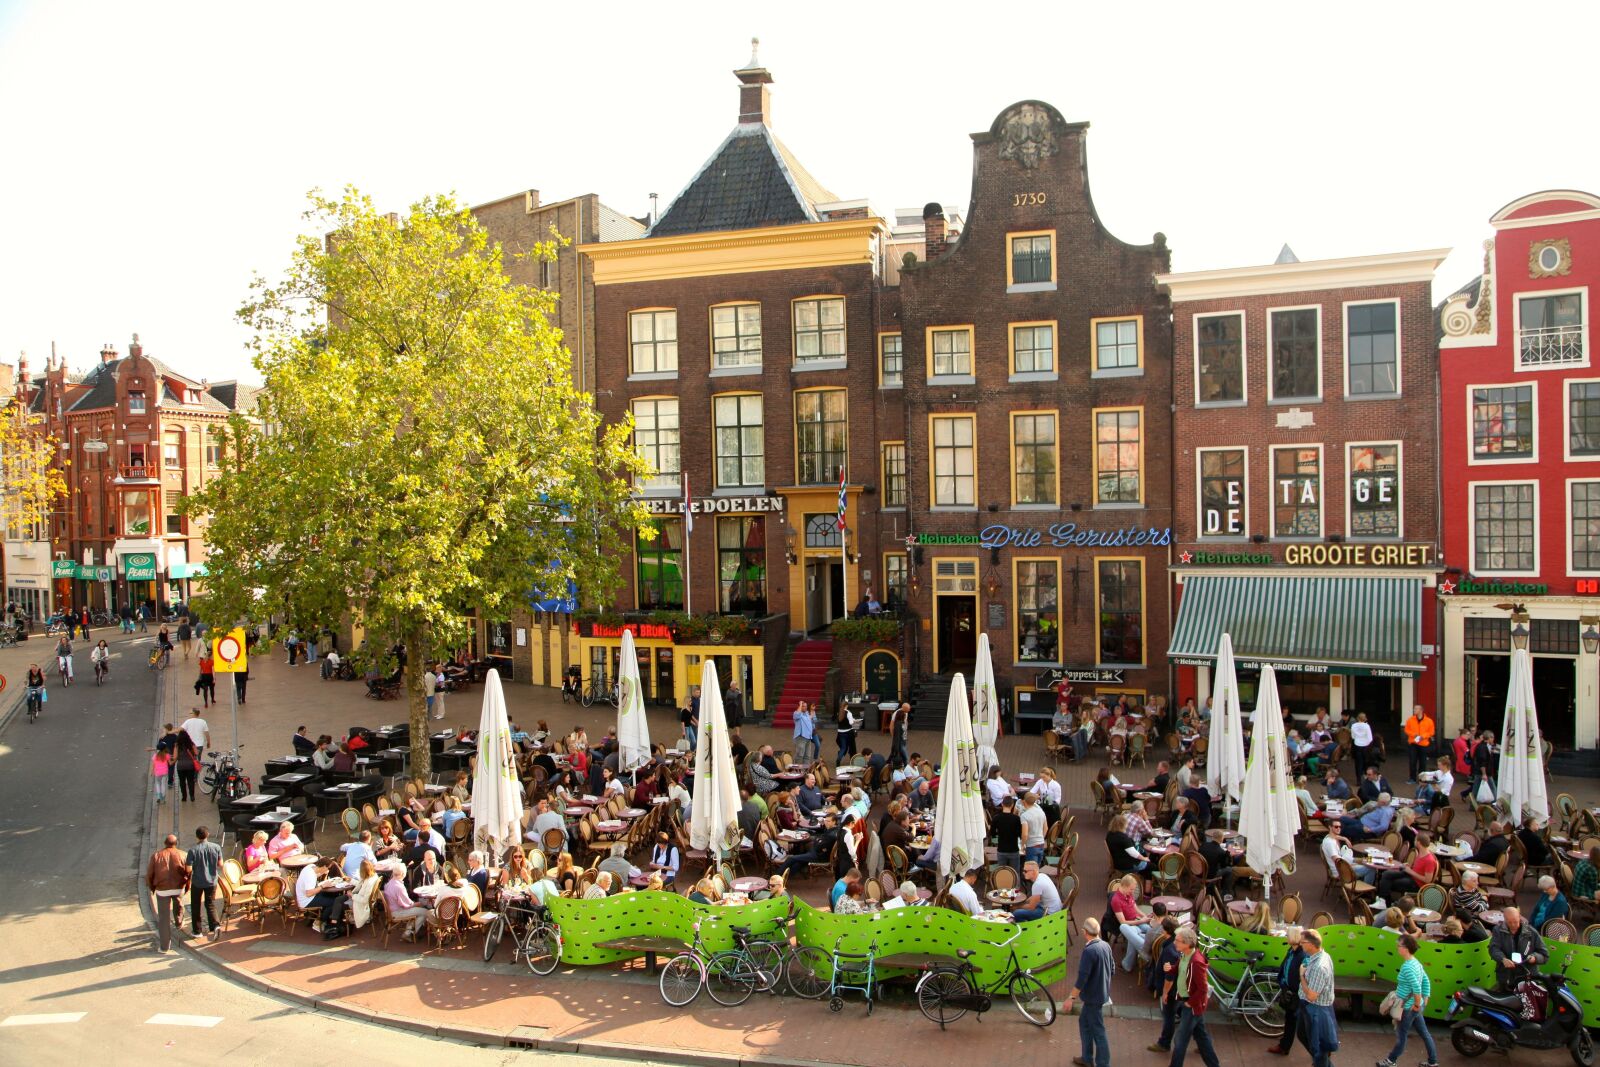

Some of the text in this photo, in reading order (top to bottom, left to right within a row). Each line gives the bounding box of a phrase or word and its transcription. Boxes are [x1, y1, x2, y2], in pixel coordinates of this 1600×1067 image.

[703, 497, 783, 513] DOELEN
[919, 534, 979, 545] Heineken
[980, 523, 1171, 548] Drie Gezusters
[1196, 551, 1272, 564] Heineken
[1285, 545, 1430, 565] GROOTE GRIET
[1459, 581, 1548, 594] Heineken
[1180, 658, 1211, 666] Heineken
[1378, 669, 1413, 678] Heineken
